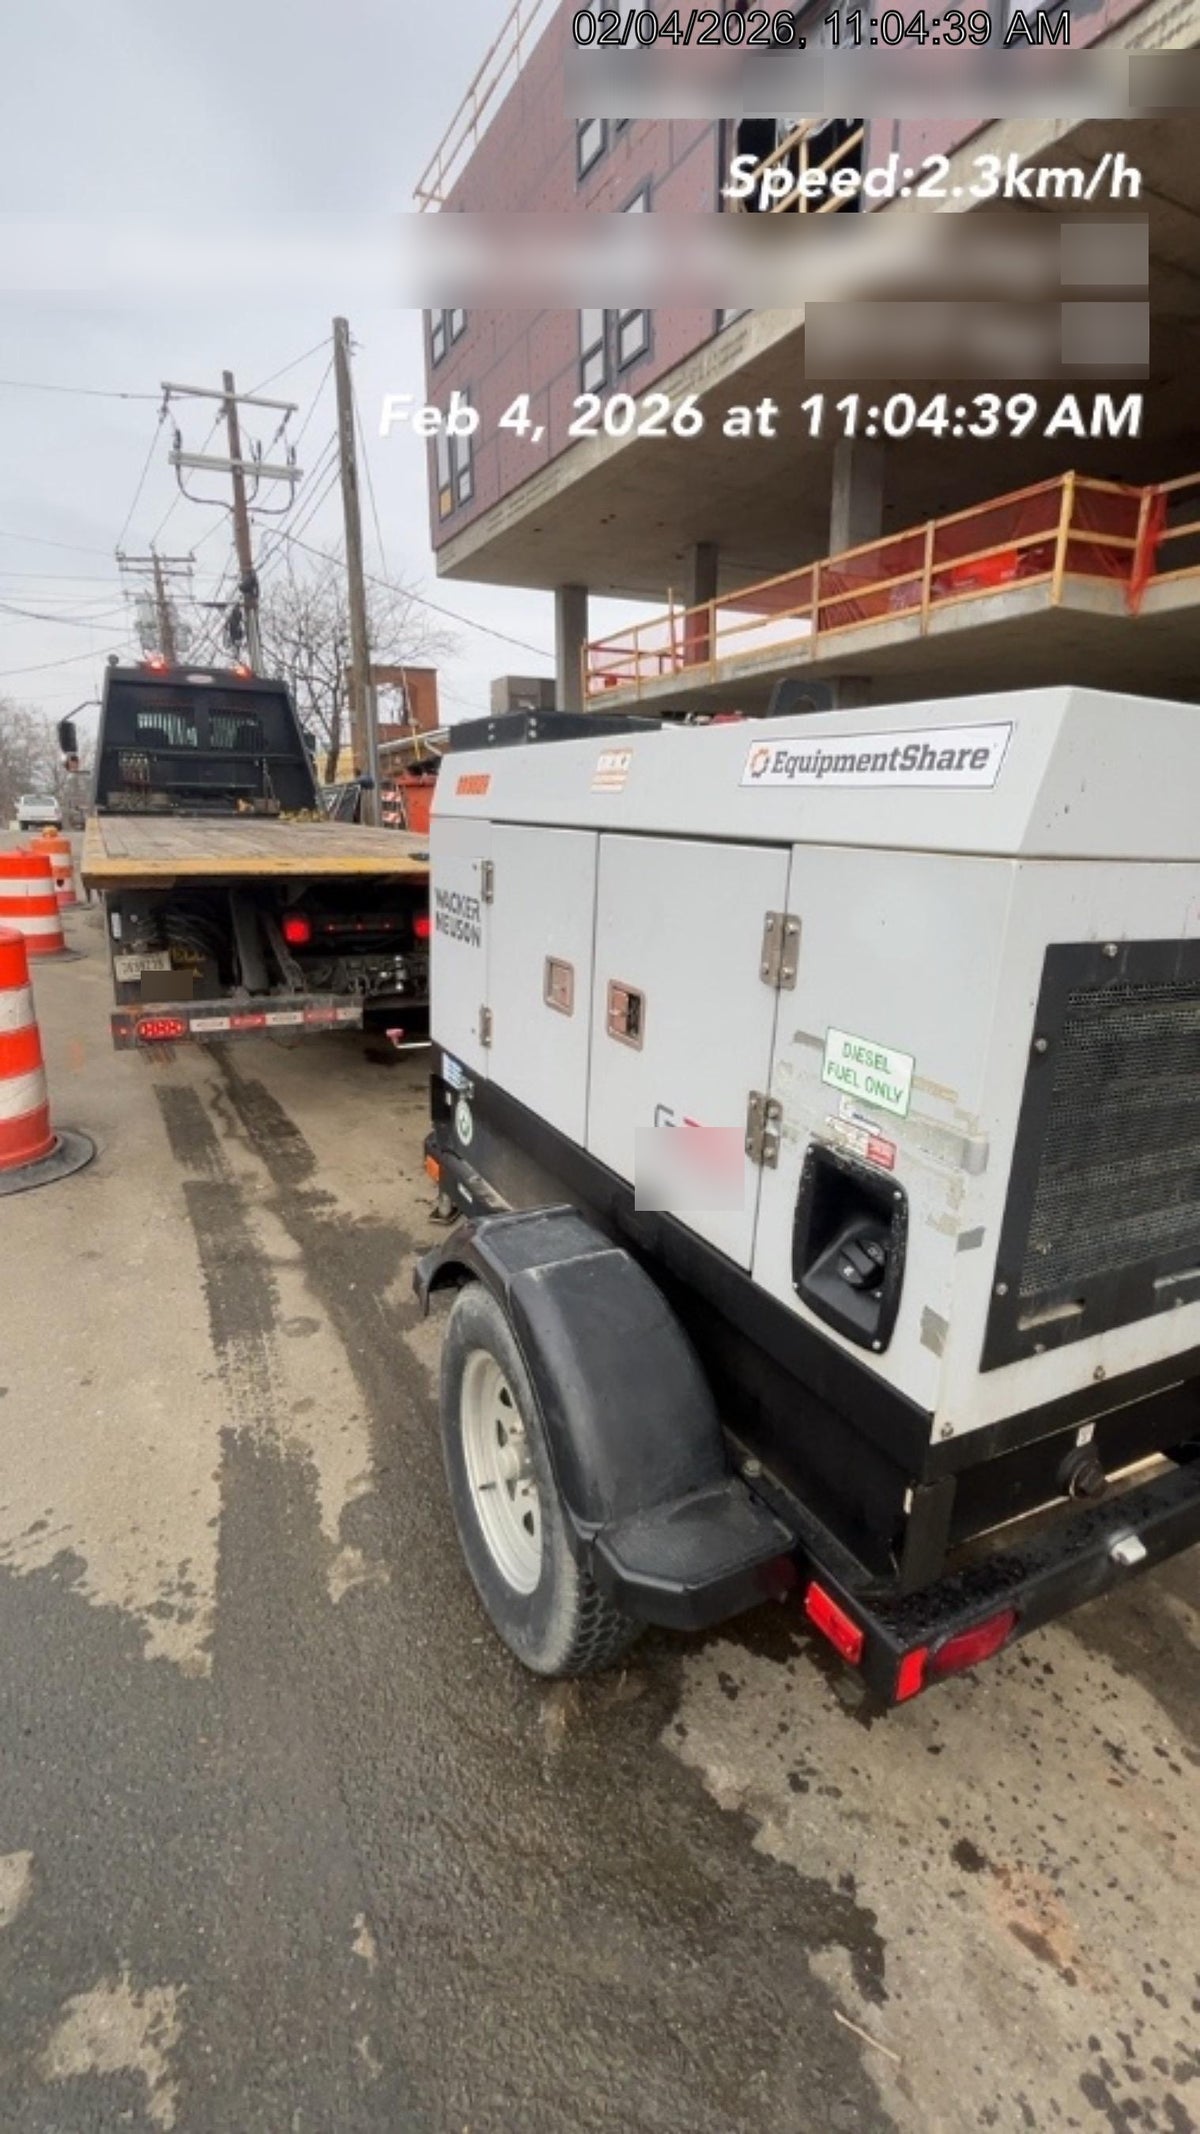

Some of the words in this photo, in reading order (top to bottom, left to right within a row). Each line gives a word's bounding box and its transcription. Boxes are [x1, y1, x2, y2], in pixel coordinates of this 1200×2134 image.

[771, 743, 990, 778] EquipmentShare
[434, 887, 480, 922] WACKER
[435, 909, 481, 948] NEUSON
[842, 1042, 891, 1075] DIESEL
[827, 1060, 860, 1089] FUEL
[865, 1075, 903, 1103] ONLY
